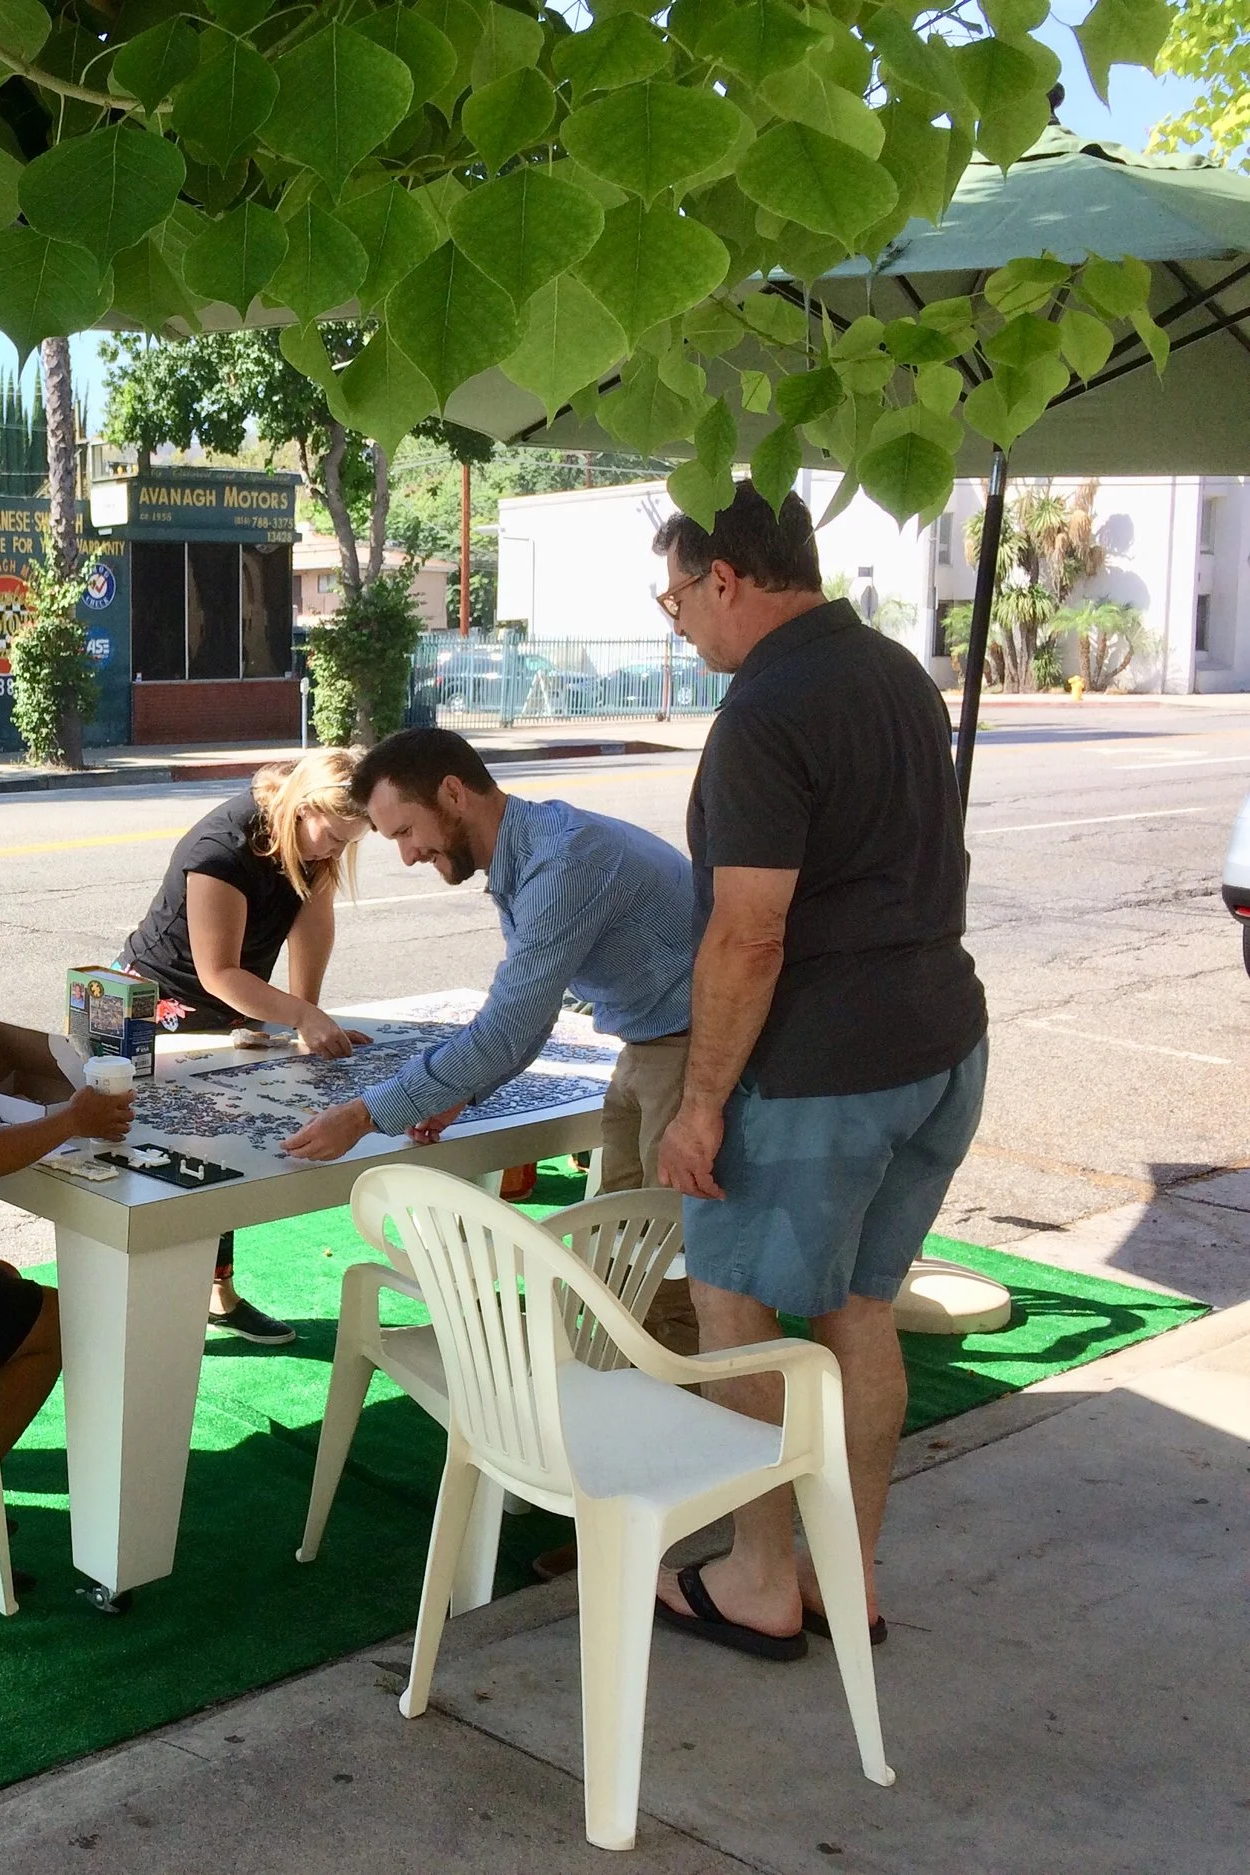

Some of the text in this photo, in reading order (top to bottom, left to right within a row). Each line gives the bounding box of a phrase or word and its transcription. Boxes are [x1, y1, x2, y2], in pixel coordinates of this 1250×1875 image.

[138, 486, 288, 510] AVANAGH MOTORS
[12, 536, 33, 554] FOR
[86, 638, 110, 655] ASE
